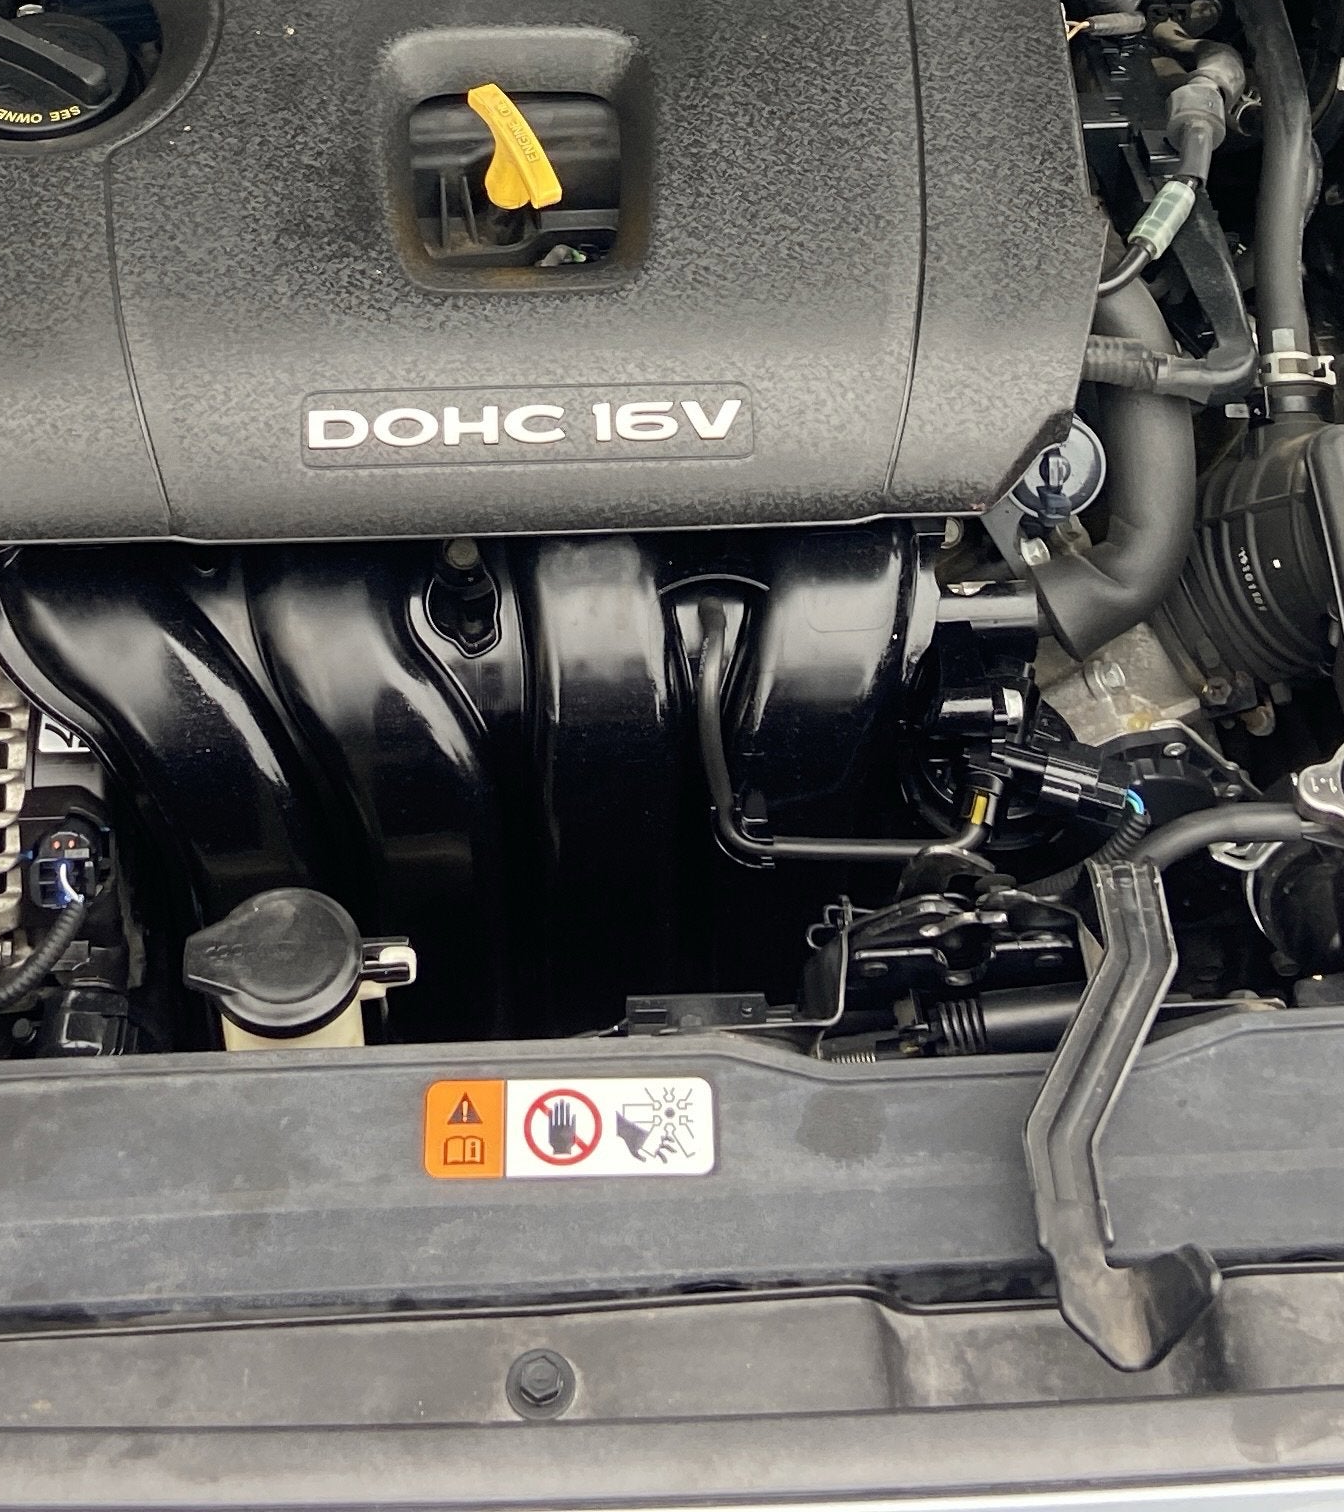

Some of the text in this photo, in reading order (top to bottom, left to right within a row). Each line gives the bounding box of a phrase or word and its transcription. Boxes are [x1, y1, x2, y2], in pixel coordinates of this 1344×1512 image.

[49, 105, 81, 122] SEE
[509, 119, 540, 163] ENGINE
[308, 398, 744, 450] DOHC 16V
